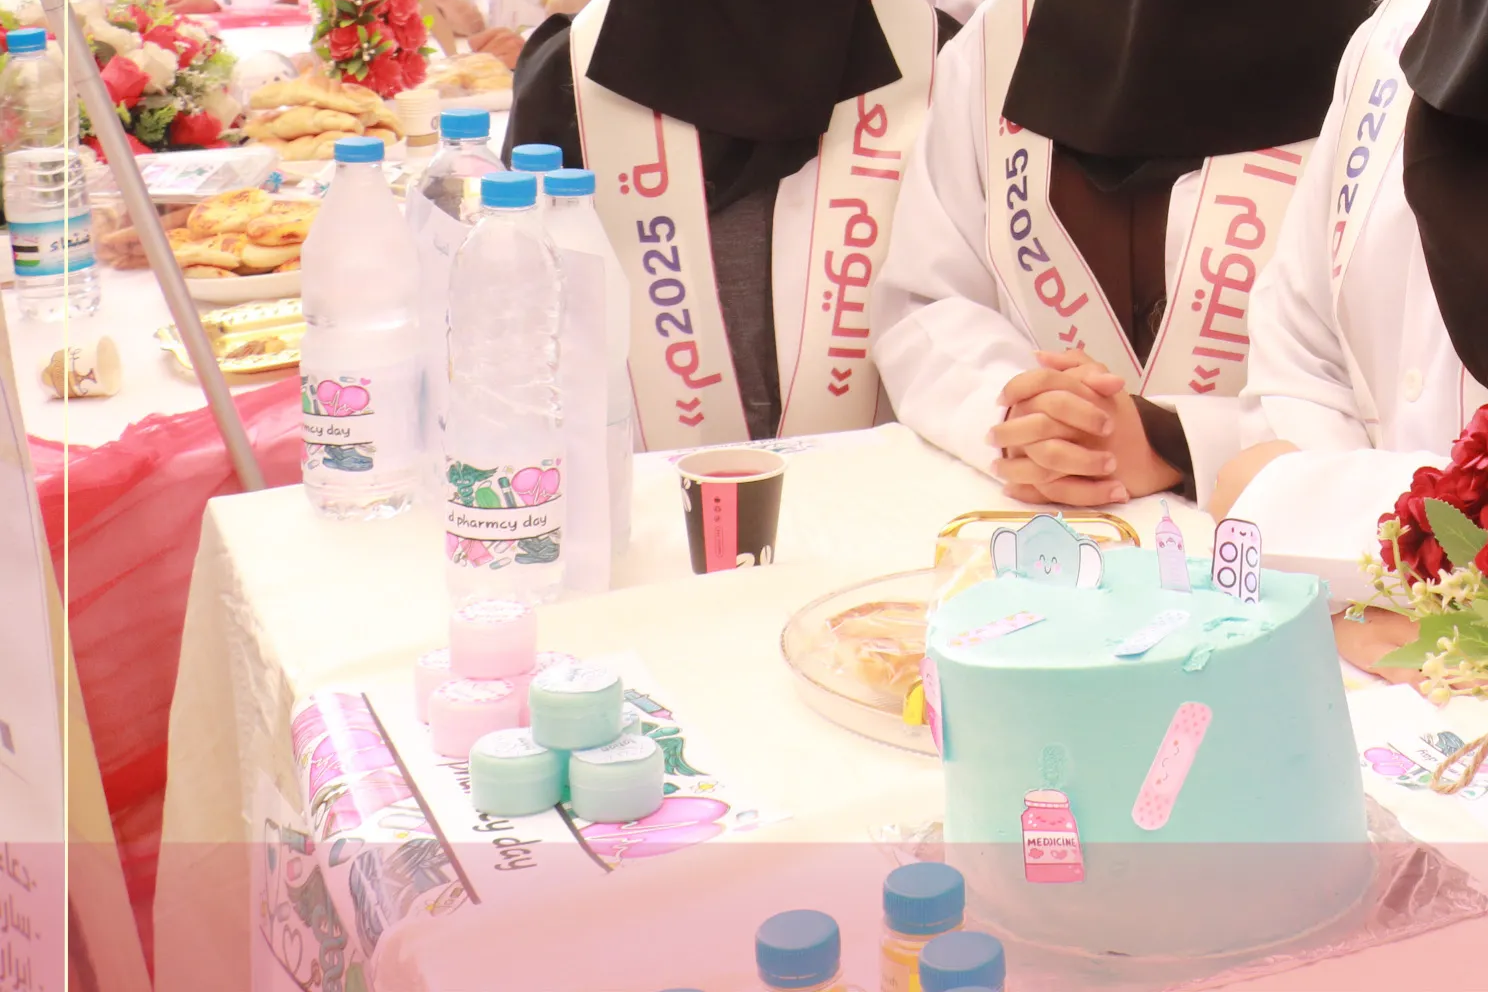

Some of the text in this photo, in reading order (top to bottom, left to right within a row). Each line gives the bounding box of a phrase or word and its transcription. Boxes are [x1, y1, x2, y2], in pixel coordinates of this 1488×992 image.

[327, 424, 351, 438] day
[456, 514, 518, 532] pharmcy
[523, 514, 547, 528] day
[492, 837, 543, 872] day
